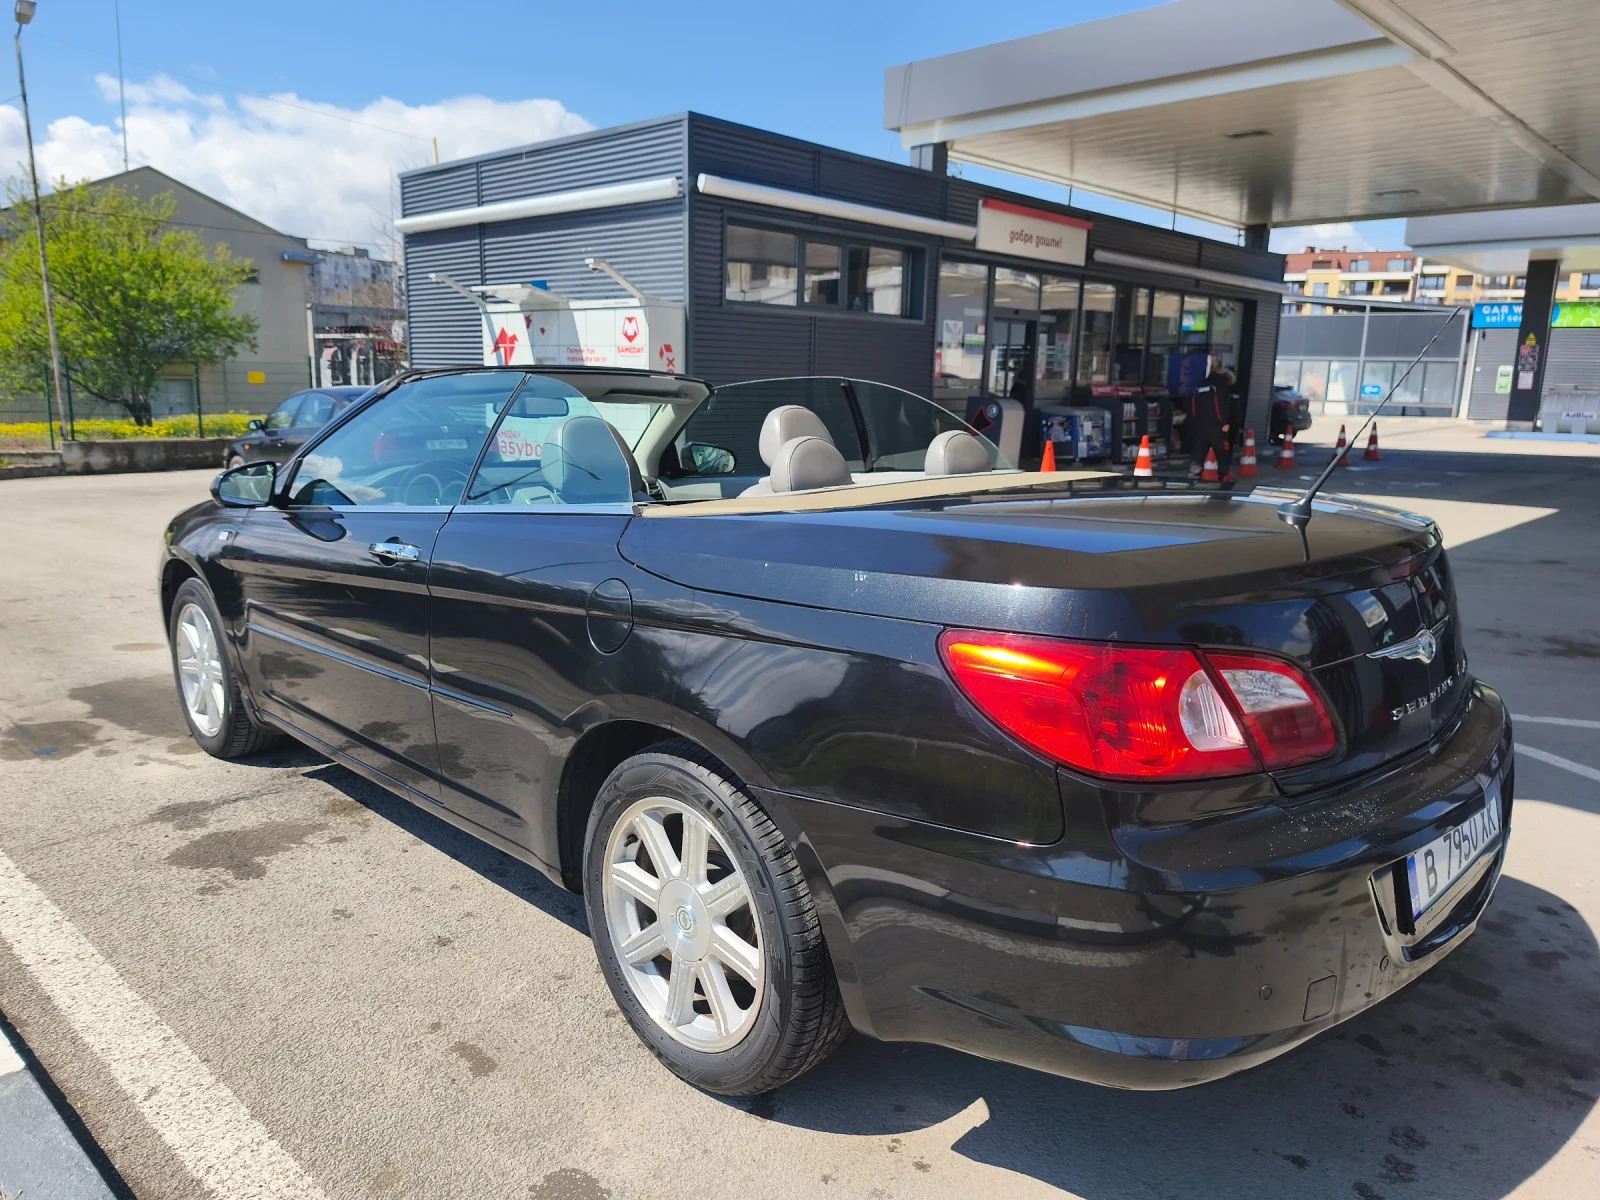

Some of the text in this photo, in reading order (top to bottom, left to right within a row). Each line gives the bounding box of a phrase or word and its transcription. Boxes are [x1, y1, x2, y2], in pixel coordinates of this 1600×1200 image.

[1482, 305, 1508, 315] CAR
[617, 346, 644, 354] SAMEDAY
[1564, 412, 1594, 420] AdBlue
[497, 429, 521, 438] AMEDAY
[500, 437, 543, 461] asybo
[1390, 676, 1453, 721] SEBRING
[1424, 804, 1496, 898] B 7950 XK
